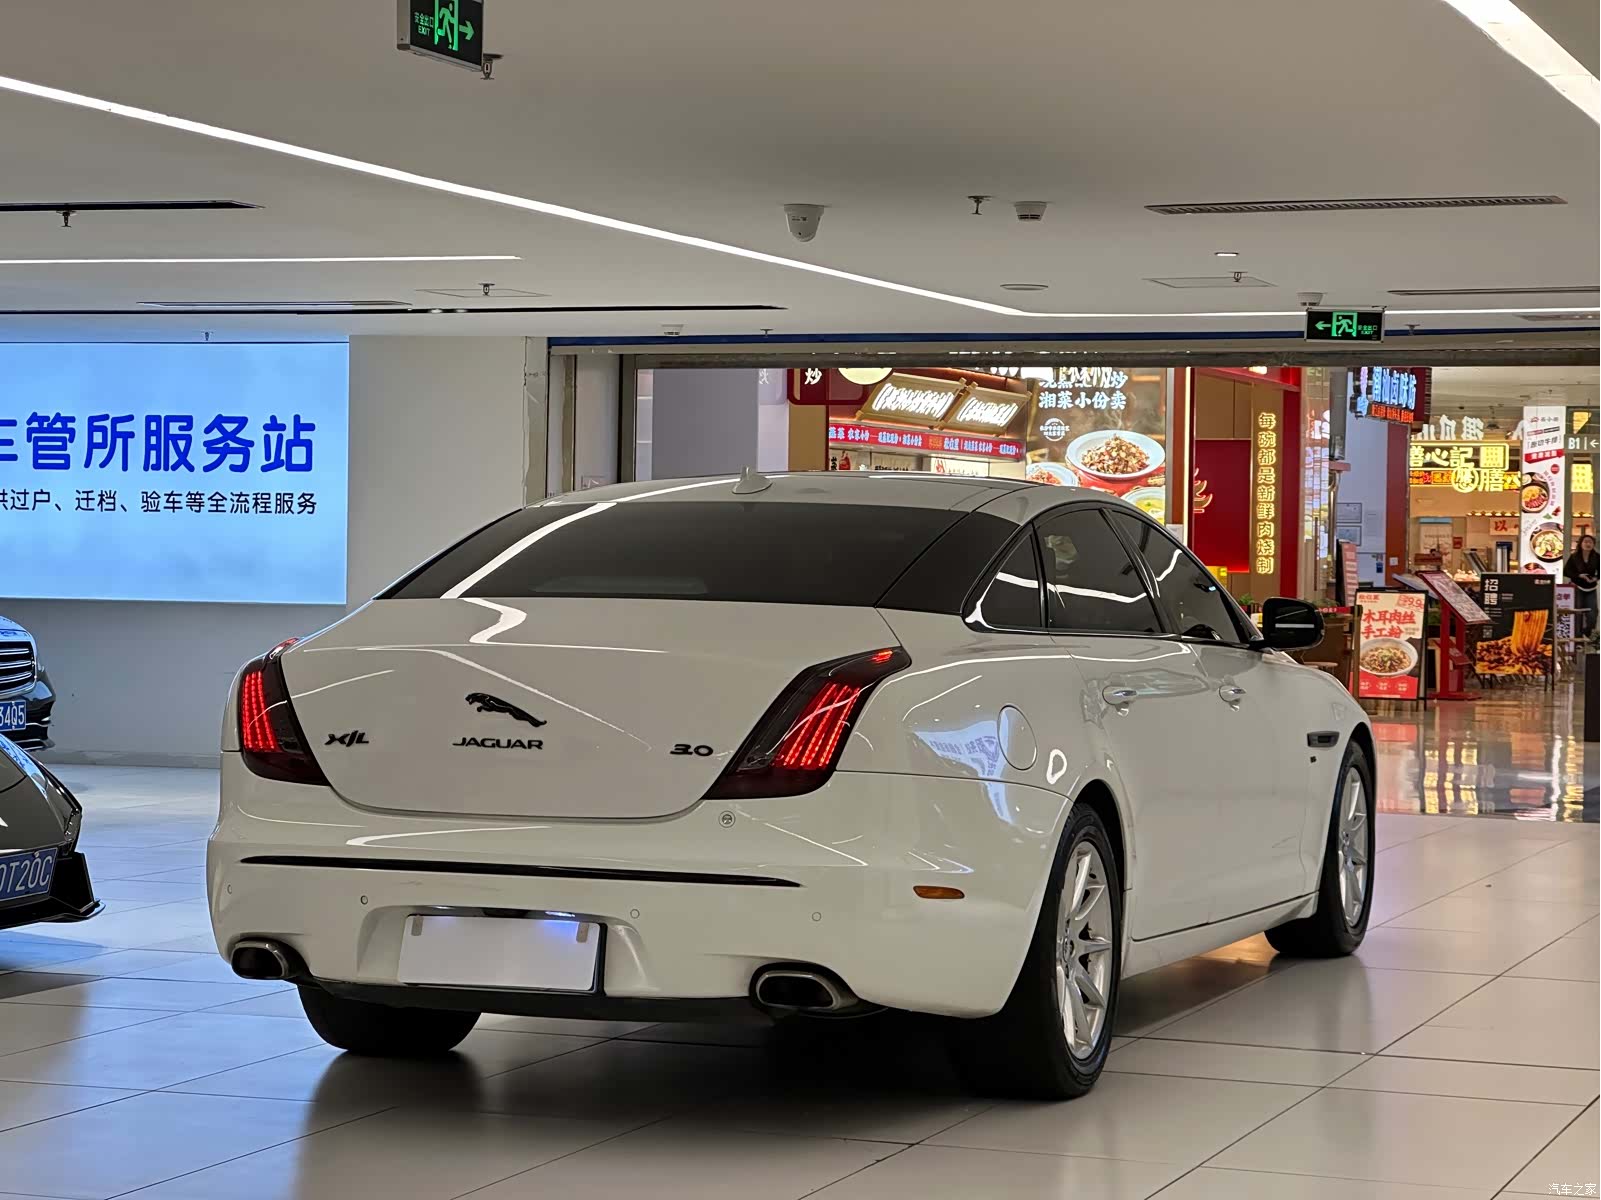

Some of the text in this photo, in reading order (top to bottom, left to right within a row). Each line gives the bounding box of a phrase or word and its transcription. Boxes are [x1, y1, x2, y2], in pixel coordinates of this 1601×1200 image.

[418, 25, 430, 36] EXIT
[804, 367, 822, 384] 炒
[1038, 390, 1127, 409] 湘菜小份卖
[1568, 437, 1580, 450] B1
[1257, 412, 1276, 574] 每碗都是新鲜肉烧制
[1484, 579, 1499, 605] 招聘
[1362, 609, 1416, 625] 木耳肉丝
[1361, 624, 1404, 639] 手工粉
[452, 737, 544, 750] JAGUAR
